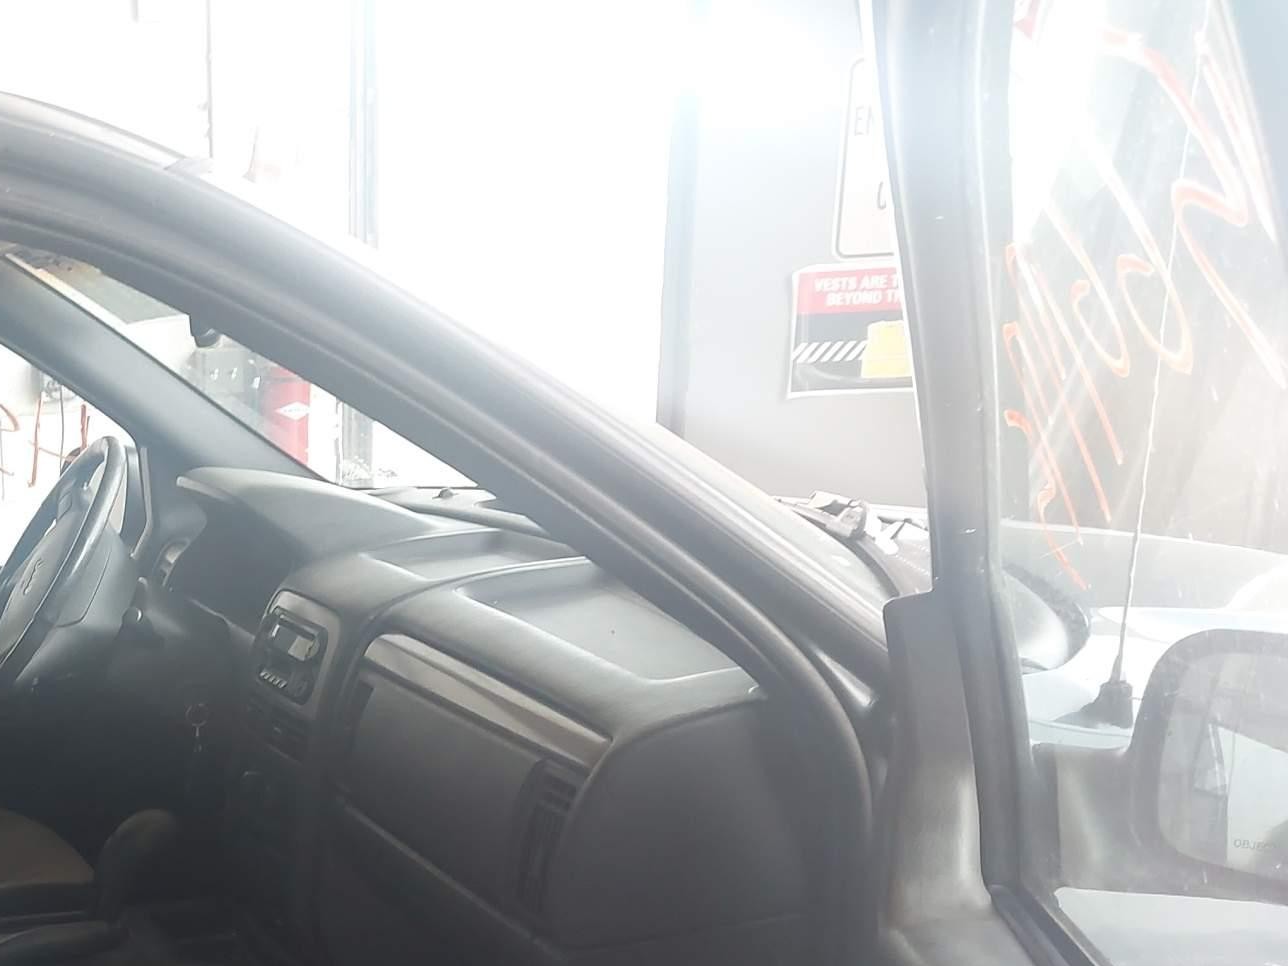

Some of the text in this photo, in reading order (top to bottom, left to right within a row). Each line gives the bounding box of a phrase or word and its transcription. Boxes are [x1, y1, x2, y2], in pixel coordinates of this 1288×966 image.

[814, 277, 858, 292] VESTS
[860, 274, 889, 290] ARE
[825, 290, 882, 307] BEYOND
